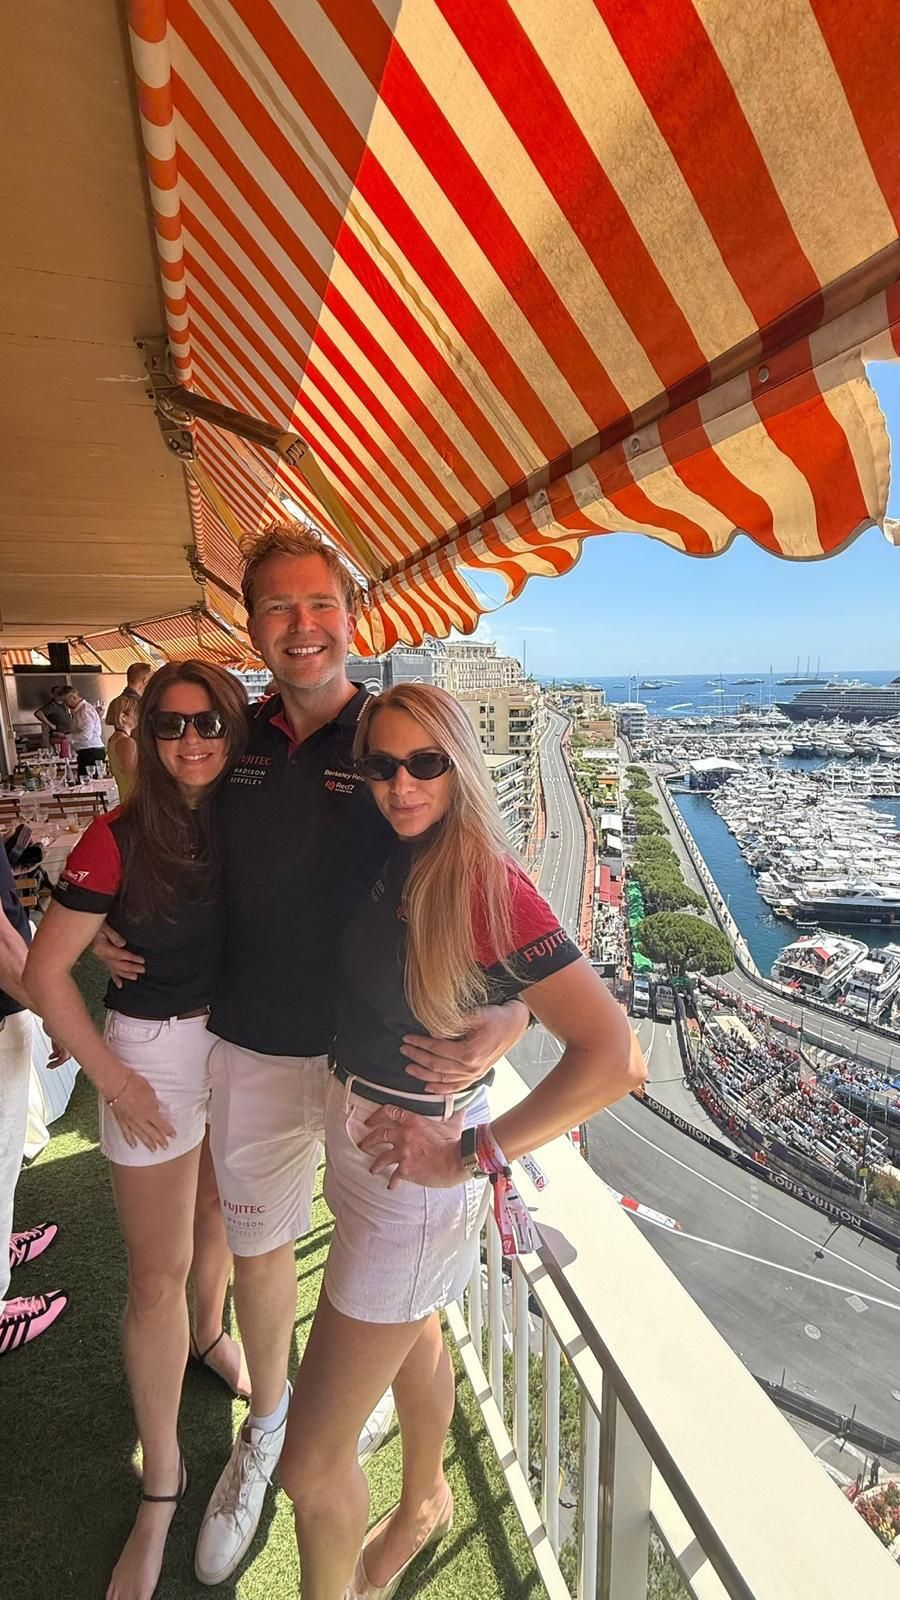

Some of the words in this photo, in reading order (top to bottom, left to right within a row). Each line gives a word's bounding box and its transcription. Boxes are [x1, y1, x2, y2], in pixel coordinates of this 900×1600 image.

[240, 754, 272, 767] UJITEC
[233, 768, 266, 776] MADISON
[324, 769, 352, 780] Berkeley
[336, 782, 355, 791] Red7
[523, 929, 569, 962] FUJITE
[648, 1098, 672, 1119] LOUIS
[673, 1115, 711, 1144] VUITTON
[769, 1173, 804, 1196] LOUIS
[807, 1192, 861, 1226] VUITTON
